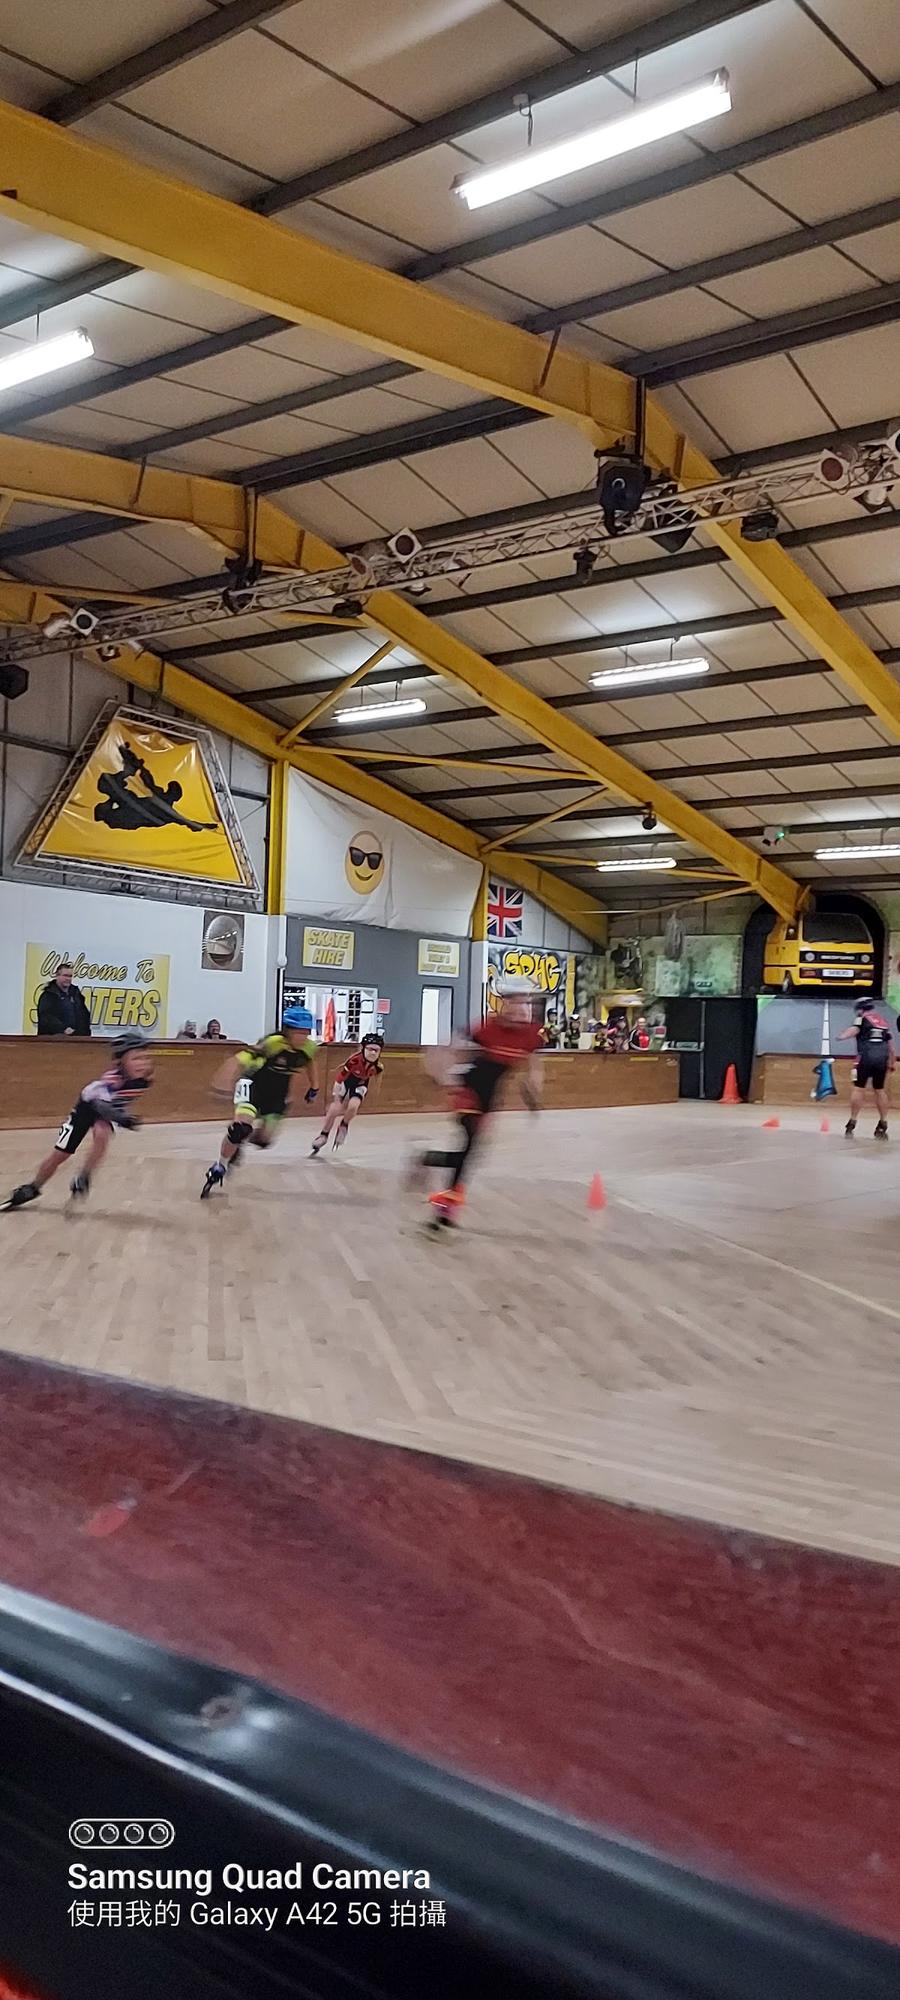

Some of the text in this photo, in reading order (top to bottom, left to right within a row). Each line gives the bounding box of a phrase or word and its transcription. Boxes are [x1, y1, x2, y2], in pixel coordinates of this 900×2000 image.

[308, 929, 351, 949] SKATE
[311, 948, 345, 967] HIRE
[135, 959, 155, 983] To
